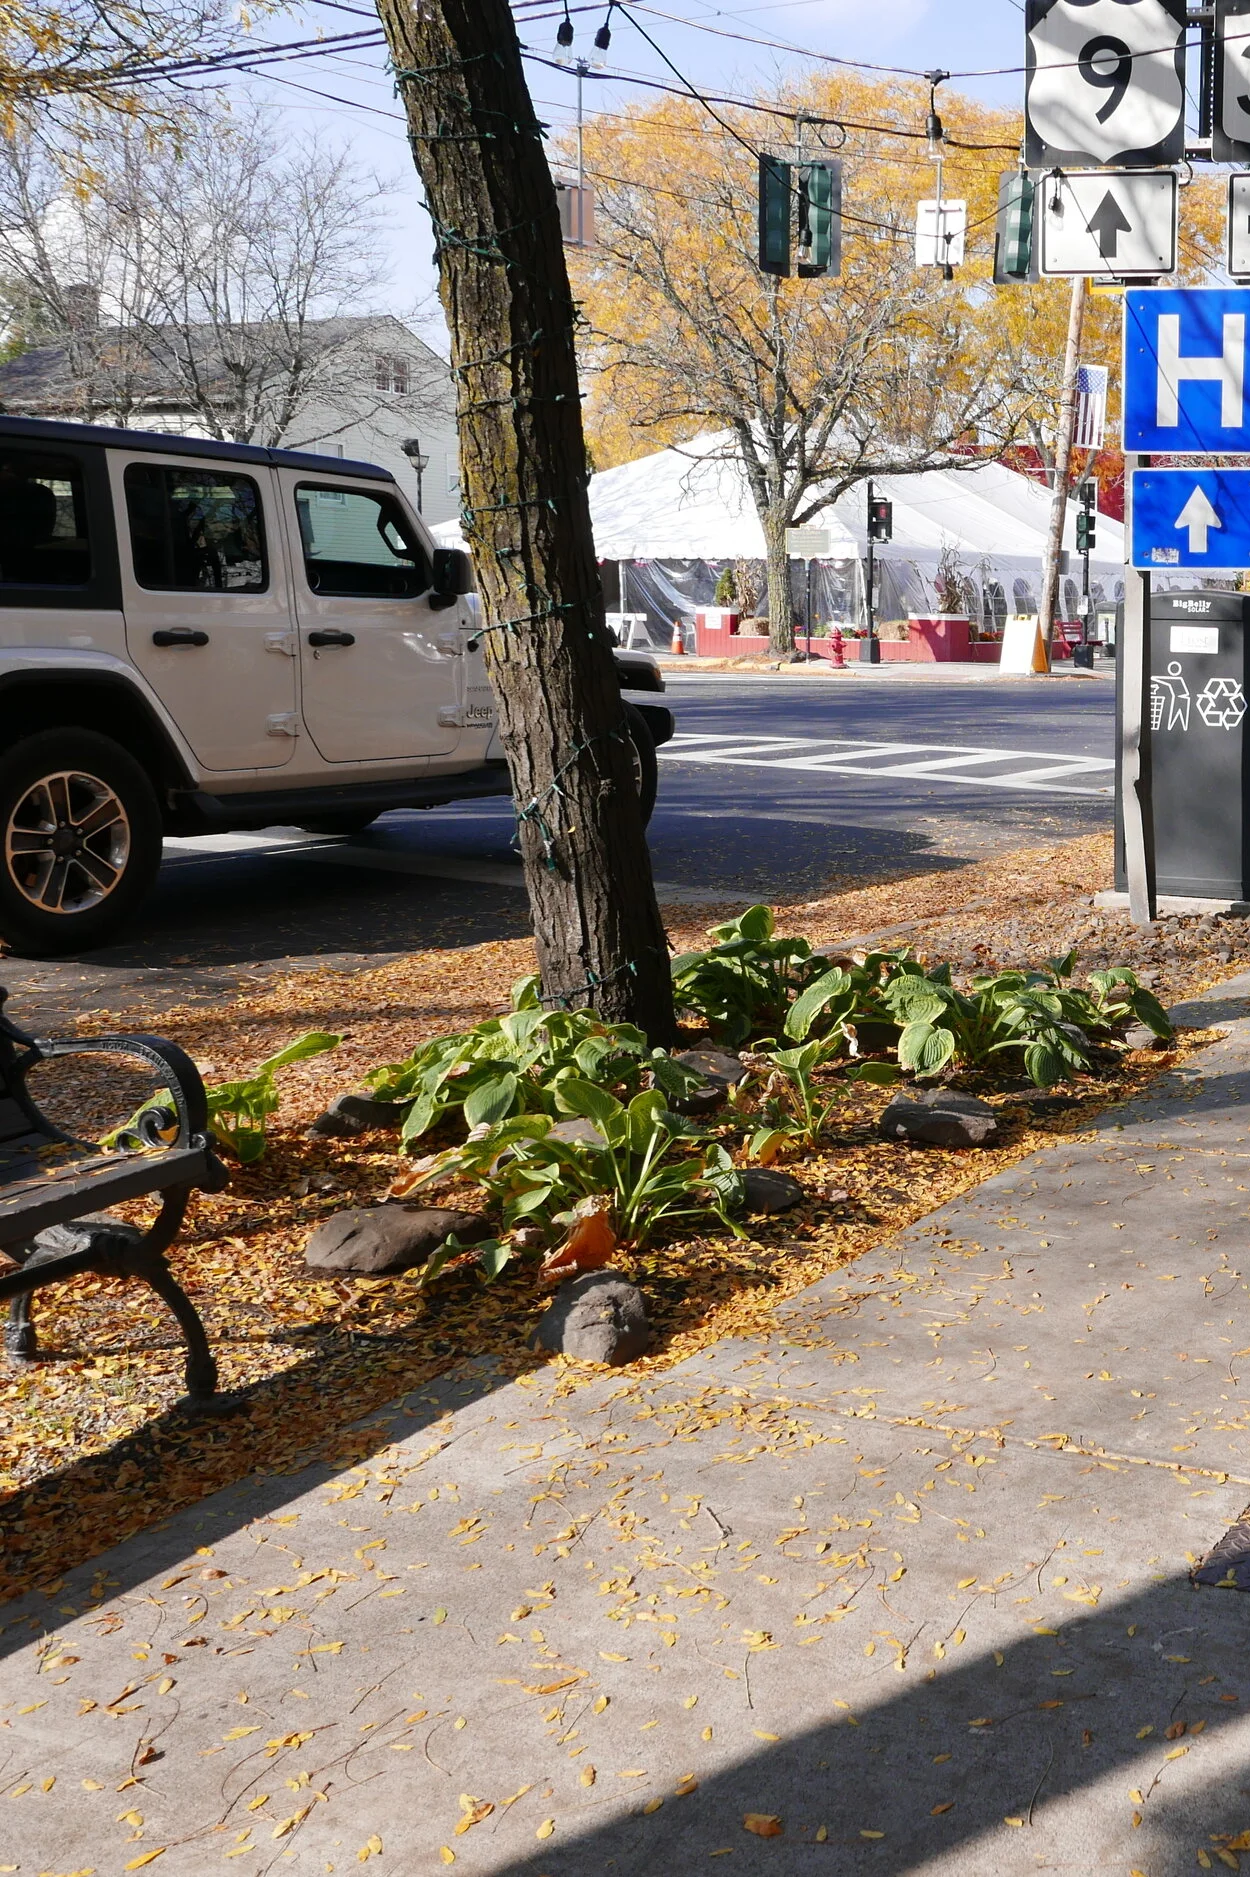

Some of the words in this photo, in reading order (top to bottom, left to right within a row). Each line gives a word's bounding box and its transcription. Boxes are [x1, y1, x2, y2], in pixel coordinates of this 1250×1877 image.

[1077, 34, 1133, 126] 9
[1156, 313, 1246, 428] H
[1172, 599, 1211, 609] BigBelly
[466, 704, 493, 720] Jeep
